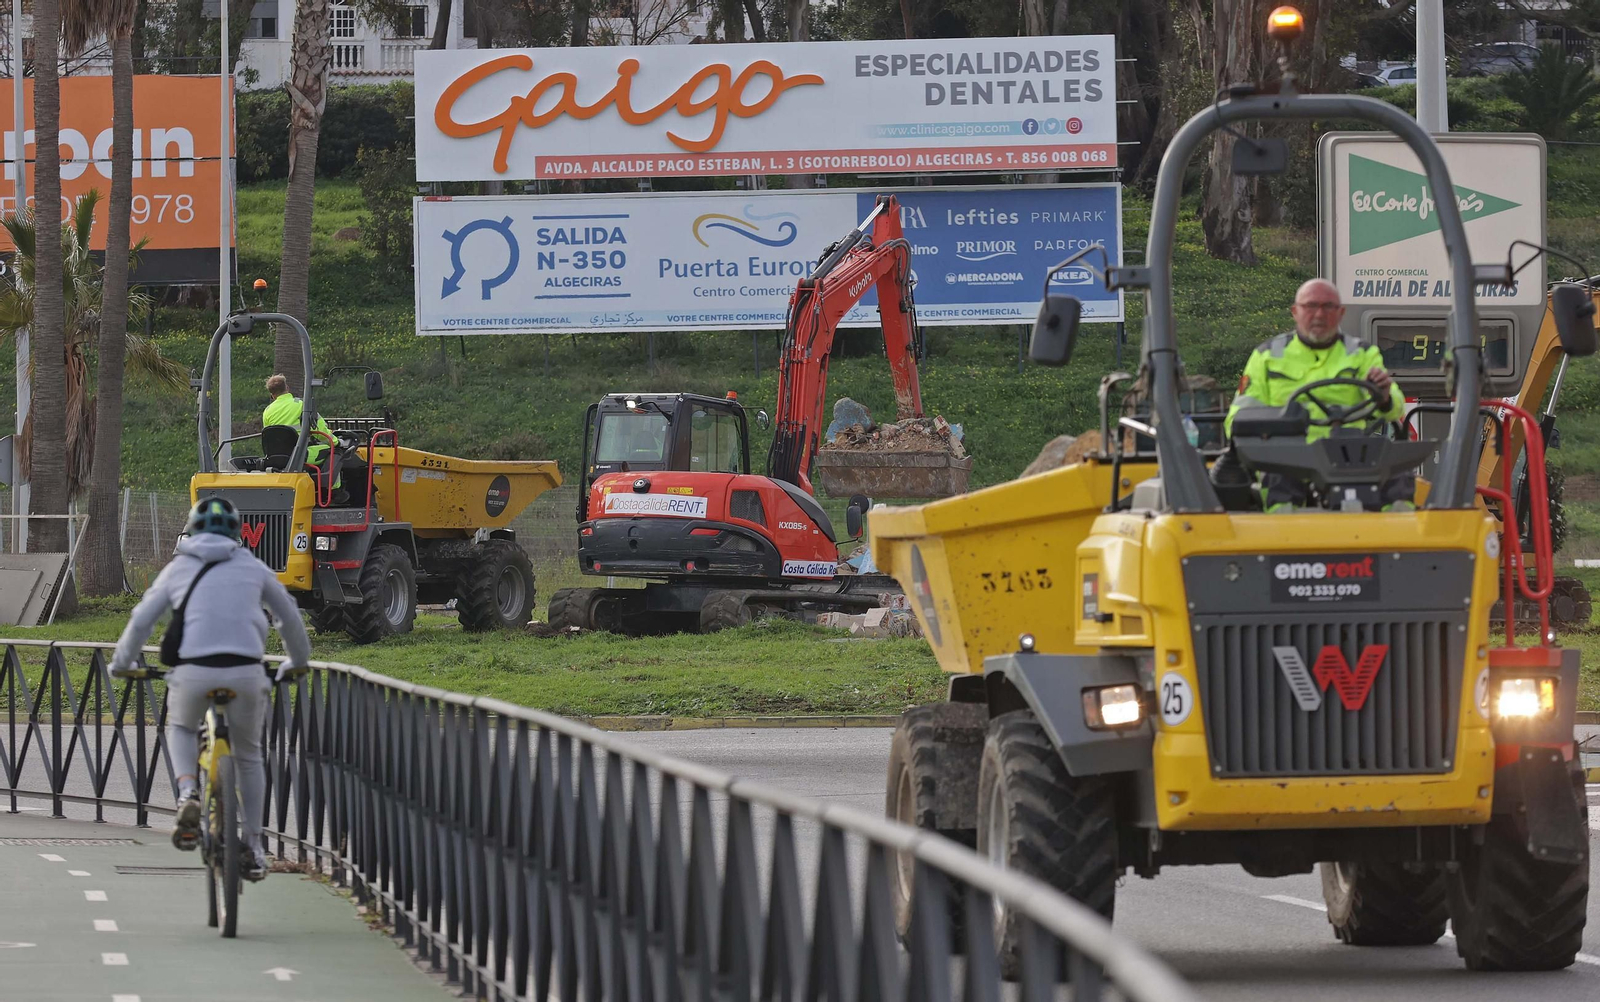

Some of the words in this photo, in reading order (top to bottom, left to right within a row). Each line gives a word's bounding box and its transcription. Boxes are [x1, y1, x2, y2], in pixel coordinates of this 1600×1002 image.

[855, 50, 1100, 78] ESPECIALIDADES
[925, 79, 1103, 106] DENTALES
[434, 54, 825, 174] Gaigo
[877, 123, 1010, 136] www.clinicagaigo.com
[544, 161, 588, 175] AVDA.
[591, 159, 654, 173] ALCALDE
[657, 158, 695, 172] PACO
[698, 156, 766, 171] ESTEBAN,
[770, 156, 783, 169] L.
[786, 156, 795, 169] 3
[798, 152, 912, 171] (SOTORREBOLO)
[916, 152, 993, 166] ALGECIRAS
[1006, 152, 1019, 164] T.
[1022, 152, 1048, 164] 856
[1051, 151, 1078, 163] 008
[1081, 150, 1108, 163] 068
[1351, 190, 1372, 212] El
[1372, 190, 1418, 212] Corte
[947, 208, 1019, 226] lefties
[1031, 211, 1106, 223] PRIMARK
[536, 227, 627, 246] SALIDA
[956, 240, 1017, 253] PRIMOR
[537, 250, 627, 270] N-350
[658, 258, 739, 278] Puerta
[748, 256, 819, 279] Europ
[957, 272, 1024, 282] MERCADONA
[1052, 271, 1090, 280] IKEA
[1355, 268, 1385, 276] CENTRO
[1387, 268, 1429, 276] COMERCIAL
[544, 276, 622, 287] ALGECIRAS
[848, 272, 872, 298] Kubota
[1353, 277, 1402, 297] BAHÍA
[1407, 280, 1429, 297] DE
[1432, 279, 1519, 297] ALCIRAS
[693, 286, 736, 297] Centro
[739, 285, 797, 297] Comercia
[442, 318, 473, 326] VOTRE
[474, 318, 510, 326] CENTRE
[511, 316, 572, 325] COMMERCIAL
[735, 313, 791, 321] COMMERCIA
[924, 309, 960, 317] CENTRE
[961, 308, 1022, 316] COMMERCIAL
[296, 535, 307, 549] 25
[783, 562, 805, 574] Costa
[806, 563, 828, 575] Cálida
[1274, 556, 1374, 580] emerent
[981, 568, 1053, 594] 3763
[1288, 584, 1313, 597] 902
[1313, 584, 1336, 596] 333
[1336, 584, 1362, 596] 070
[1162, 682, 1183, 715] 25
